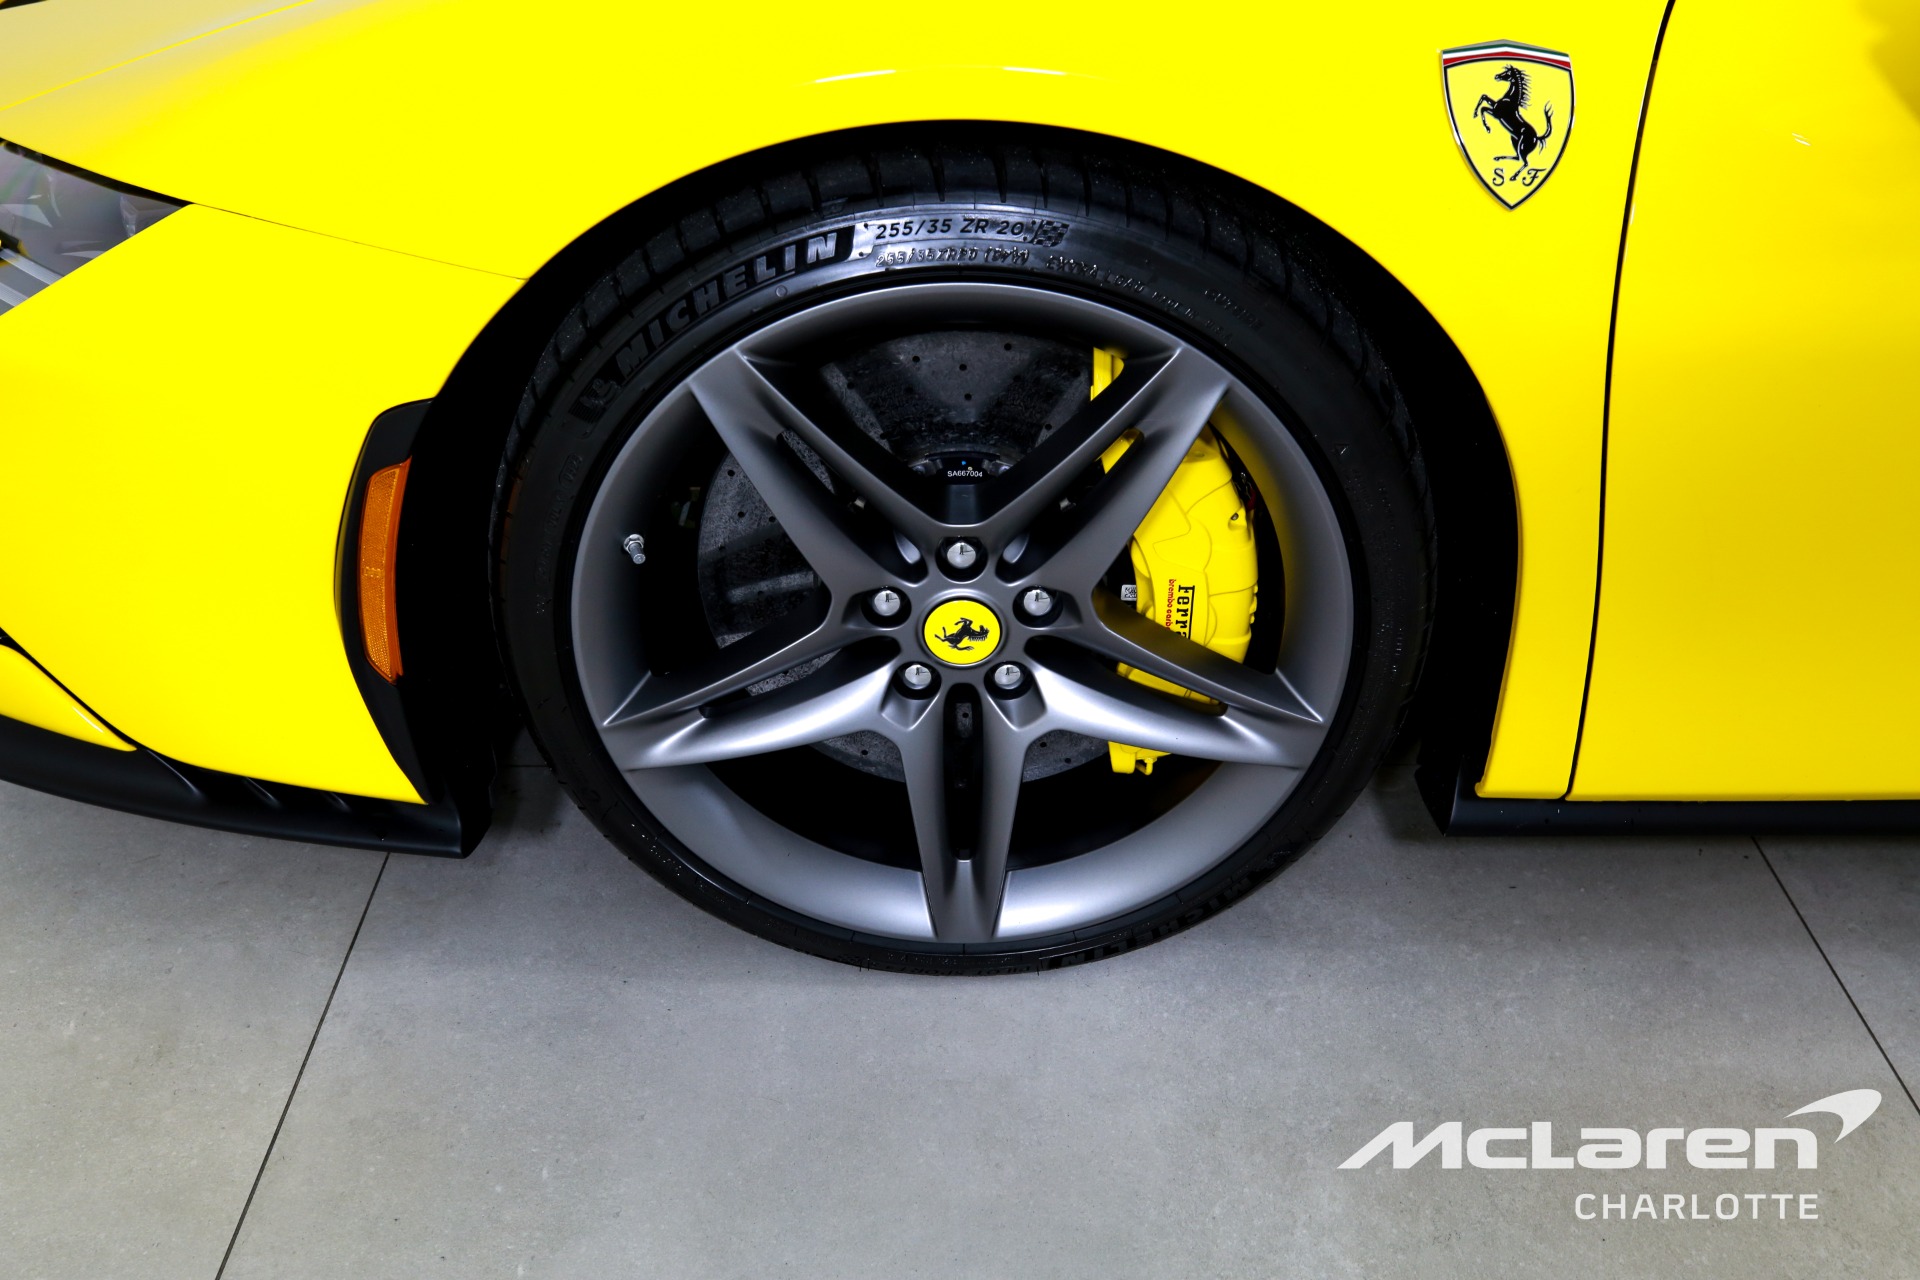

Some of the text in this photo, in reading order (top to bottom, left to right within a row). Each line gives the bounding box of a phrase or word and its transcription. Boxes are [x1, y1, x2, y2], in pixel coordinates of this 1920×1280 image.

[1492, 168, 1546, 187] S F
[875, 218, 1025, 239] 255/35 ZR 20
[616, 232, 837, 378] MICHELIN
[1167, 579, 1176, 608] brembo
